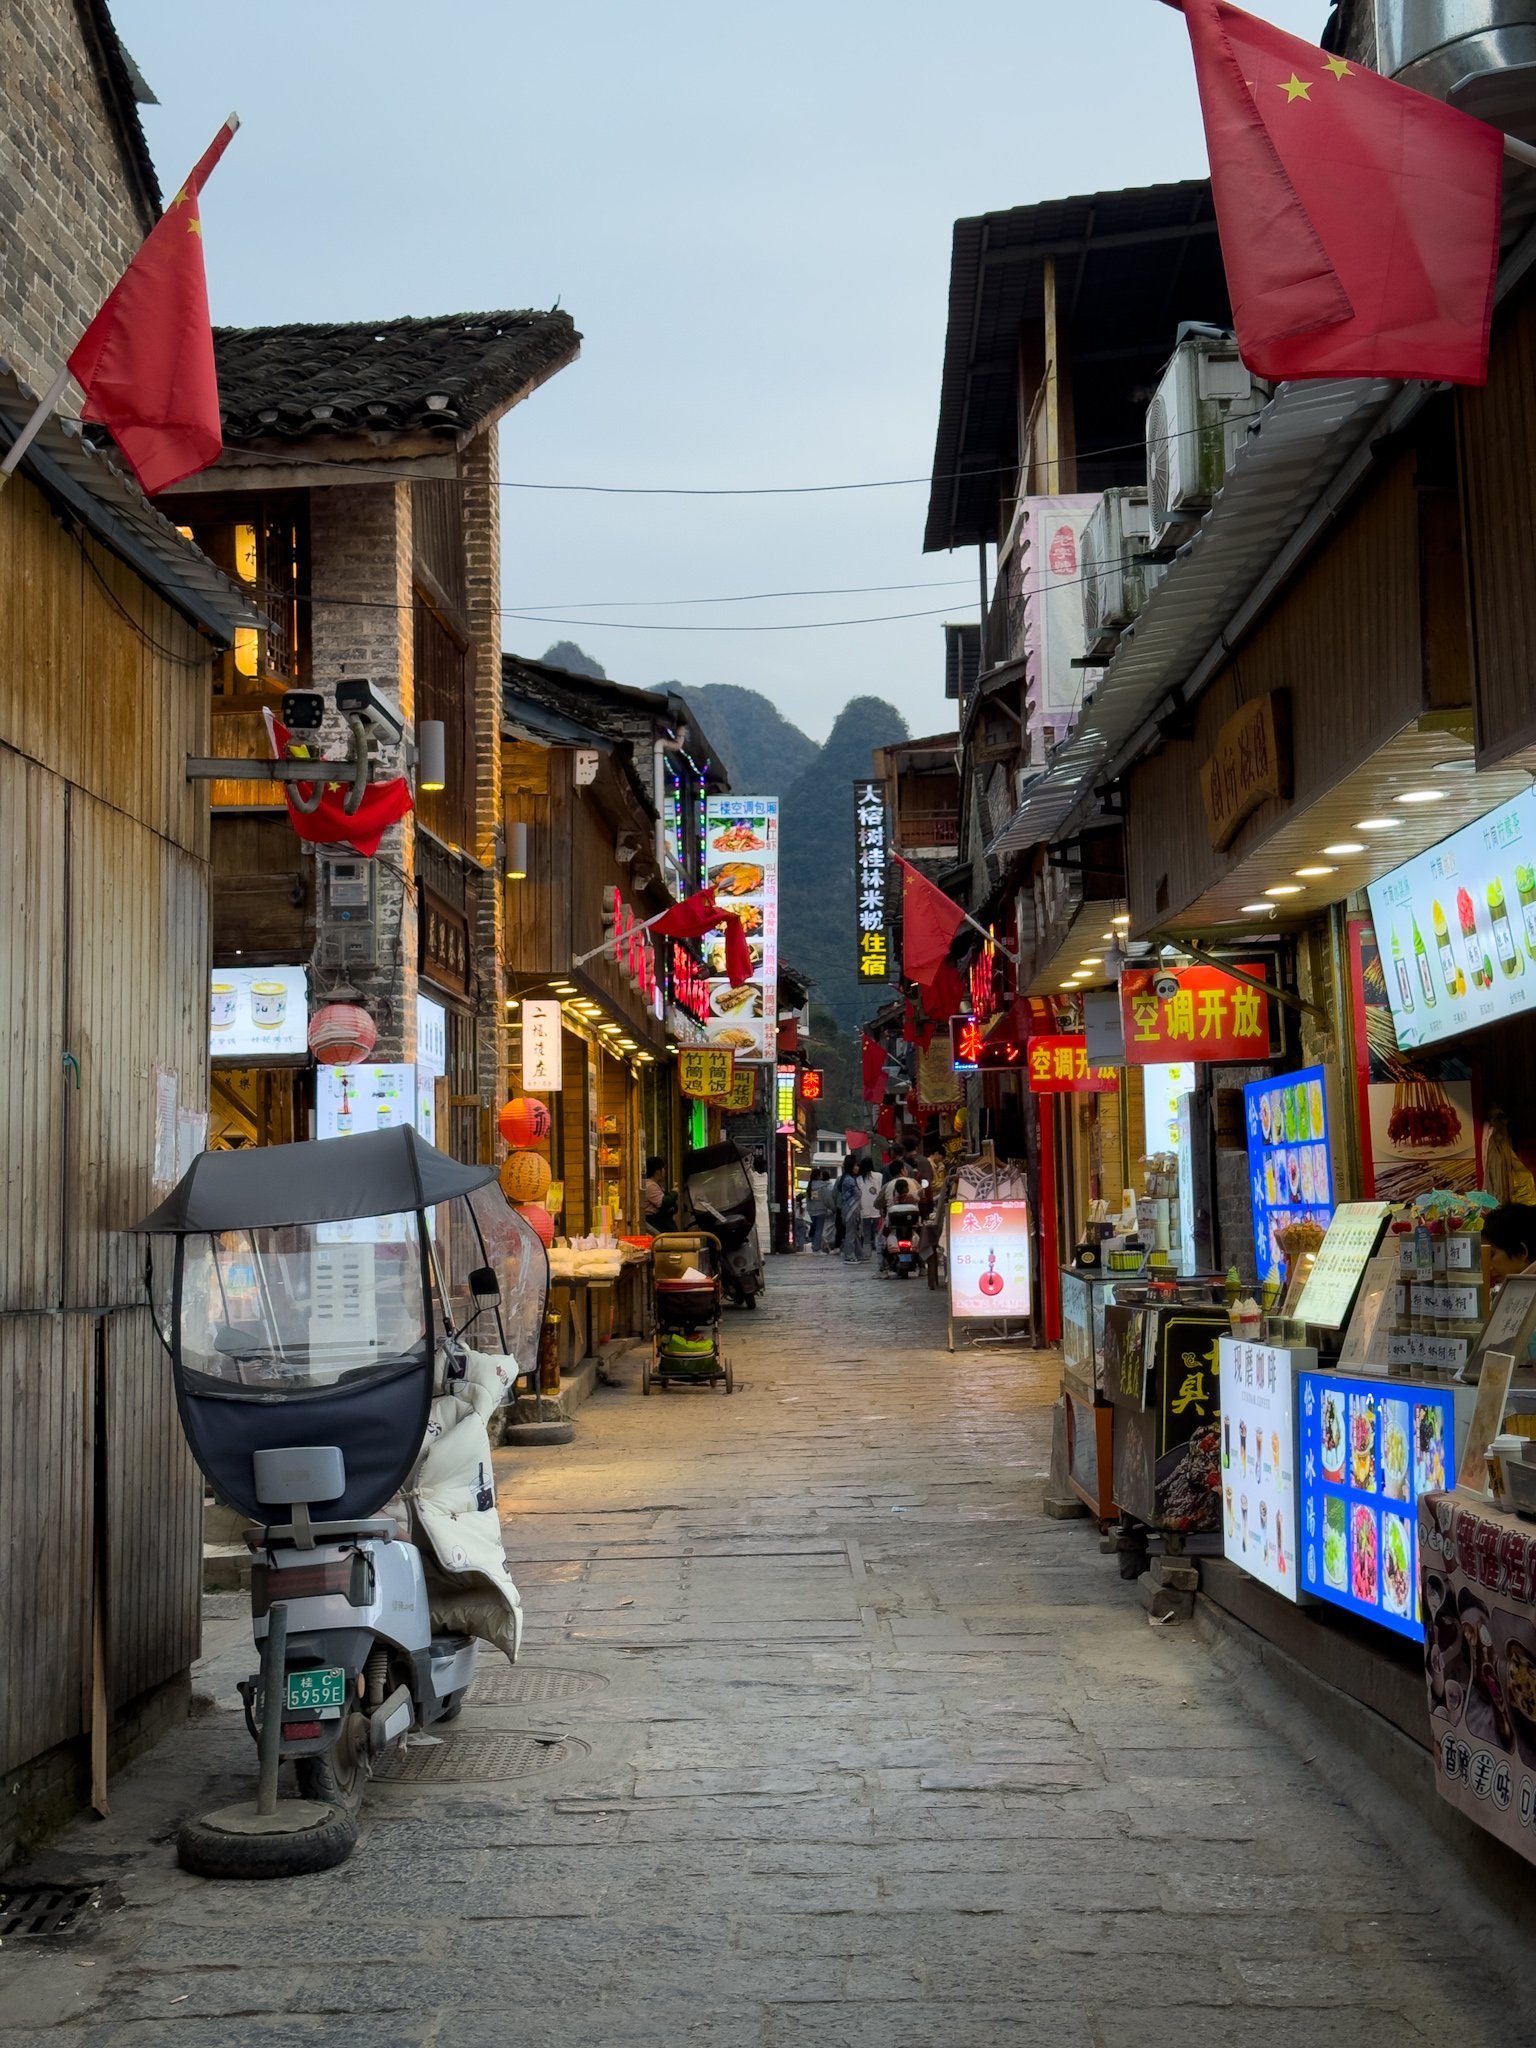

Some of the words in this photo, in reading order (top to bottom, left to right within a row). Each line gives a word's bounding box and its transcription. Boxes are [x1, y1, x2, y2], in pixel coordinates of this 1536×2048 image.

[857, 785, 885, 931] 大榕树桂林米粉
[860, 933, 887, 976] 住宿
[1131, 986, 1263, 1042] 空调开放
[684, 1053, 703, 1093] 竹筒鸡
[708, 1053, 727, 1093] 竹筒饭
[733, 1073, 750, 1106] 叫花鸡
[802, 1072, 820, 1098] 朱砂
[962, 1212, 1004, 1233] 朱砂
[1233, 1343, 1277, 1394] 现磨咖啡
[291, 1686, 341, 1706] 5959E
[300, 1677, 313, 1688] 桂
[322, 1675, 331, 1686] C
